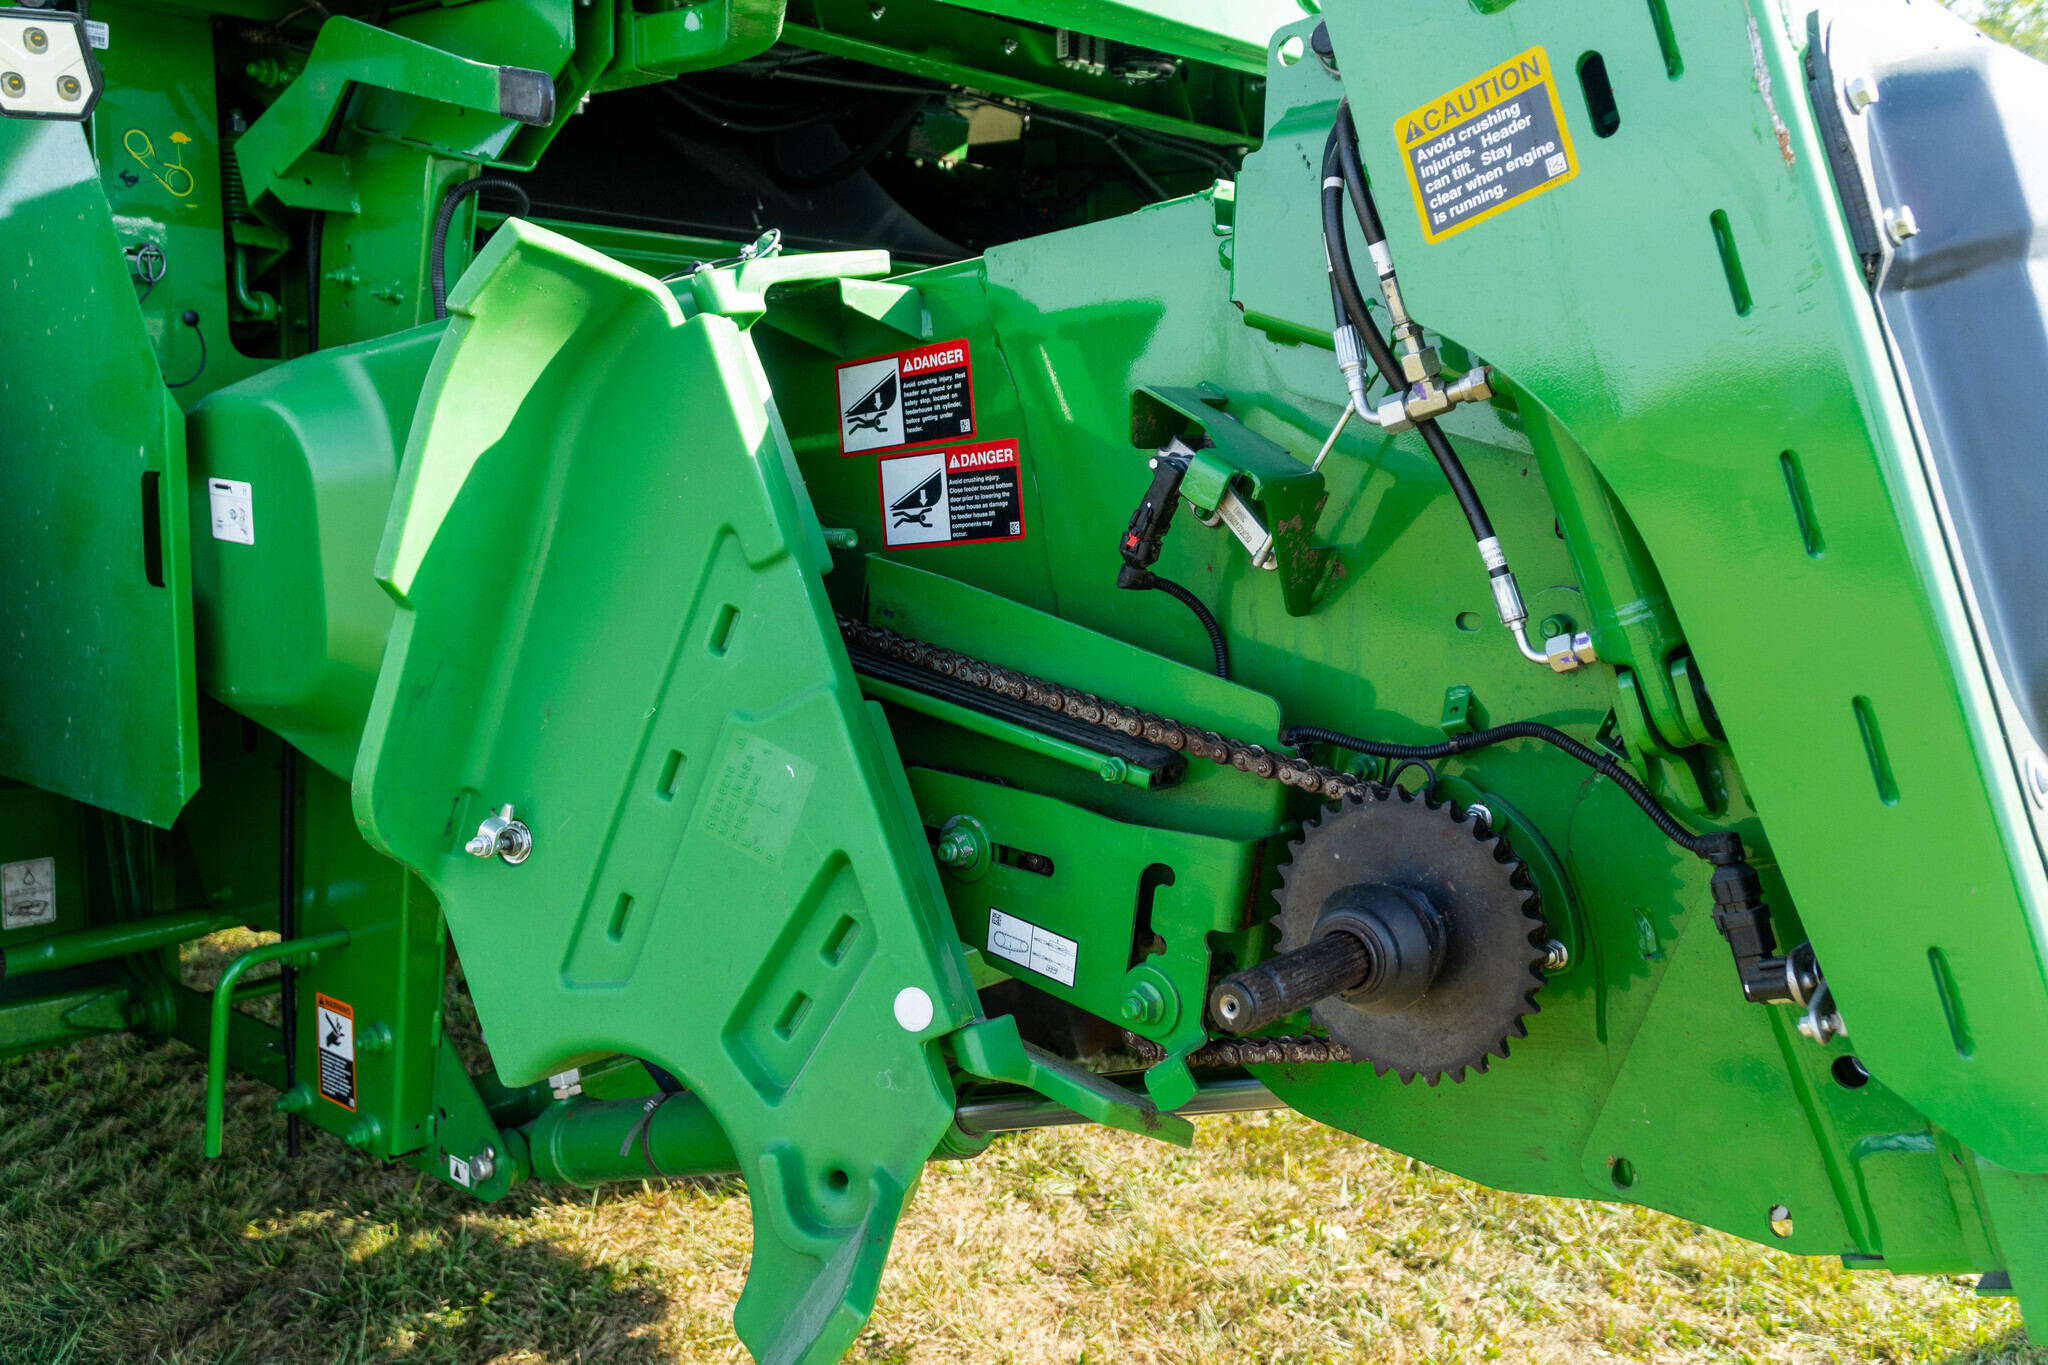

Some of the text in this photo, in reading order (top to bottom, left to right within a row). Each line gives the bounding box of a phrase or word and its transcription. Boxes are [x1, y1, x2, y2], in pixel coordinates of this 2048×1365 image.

[1424, 55, 1540, 131] CAUTION
[1417, 103, 1520, 163] Avoid crushing
[1420, 115, 1531, 178] injuries. Header
[1425, 142, 1512, 193] can tilt. Stay
[1430, 142, 1555, 209] clear when engine
[1434, 183, 1507, 225] is running.
[913, 349, 963, 370] DANGER
[917, 378, 937, 386] crushing
[929, 385, 945, 394] ground
[933, 393, 949, 401] located
[905, 406, 932, 415] feederhouse
[922, 414, 938, 423] getting
[940, 411, 953, 419] under
[961, 448, 1013, 467] DANGER
[963, 476, 984, 484] crushing
[985, 474, 1000, 482] injury.
[980, 483, 994, 491] house
[962, 494, 973, 502] prior
[981, 492, 1001, 500] lowering
[967, 502, 981, 510] house
[973, 510, 988, 518] house
[952, 521, 981, 529] components
[718, 801, 737, 835] MADE
[732, 784, 744, 798] IN
[739, 755, 755, 780] USA
